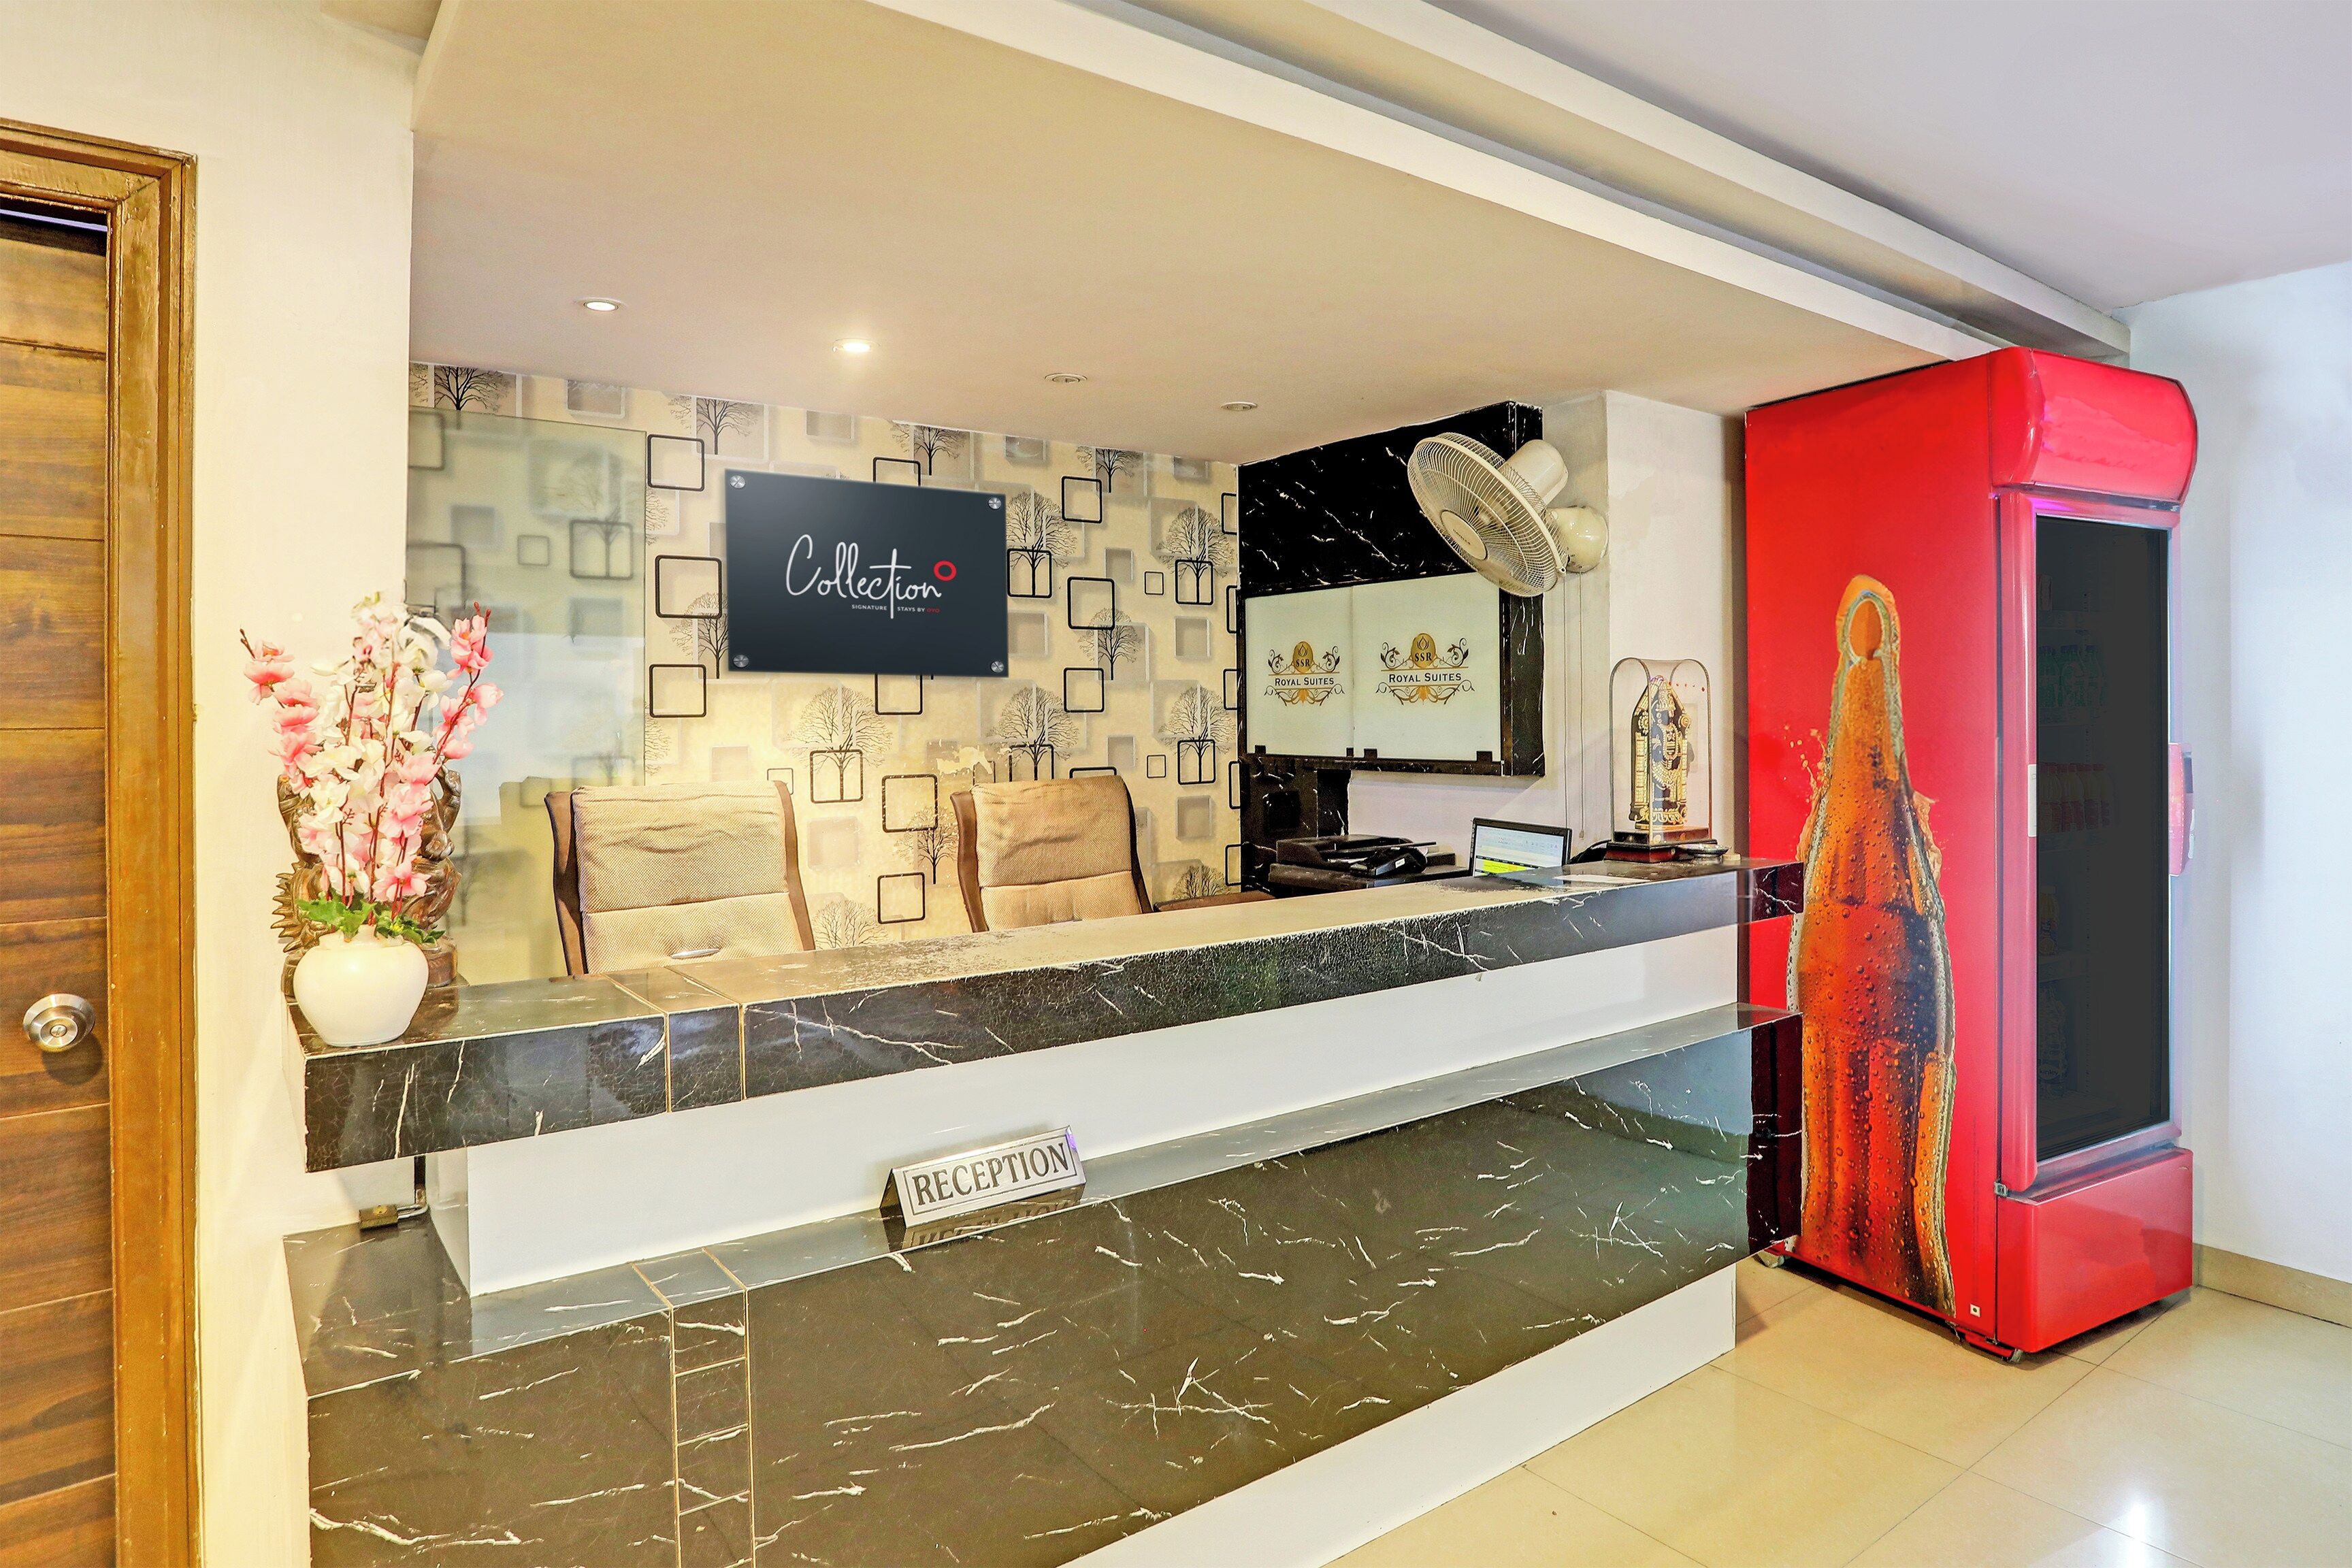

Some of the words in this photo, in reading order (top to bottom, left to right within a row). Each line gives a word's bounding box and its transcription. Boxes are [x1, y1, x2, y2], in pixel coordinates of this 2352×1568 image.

[785, 534, 942, 619] Collection
[1414, 652, 1432, 662] SSR
[1296, 658, 1310, 668] SSR
[1275, 678, 1301, 686] ROYAL
[1304, 677, 1334, 685] SUITES
[1389, 674, 1421, 683] ROYAL
[1424, 672, 1461, 682] SUITES
[912, 1142, 1069, 1206] RECEPTION
